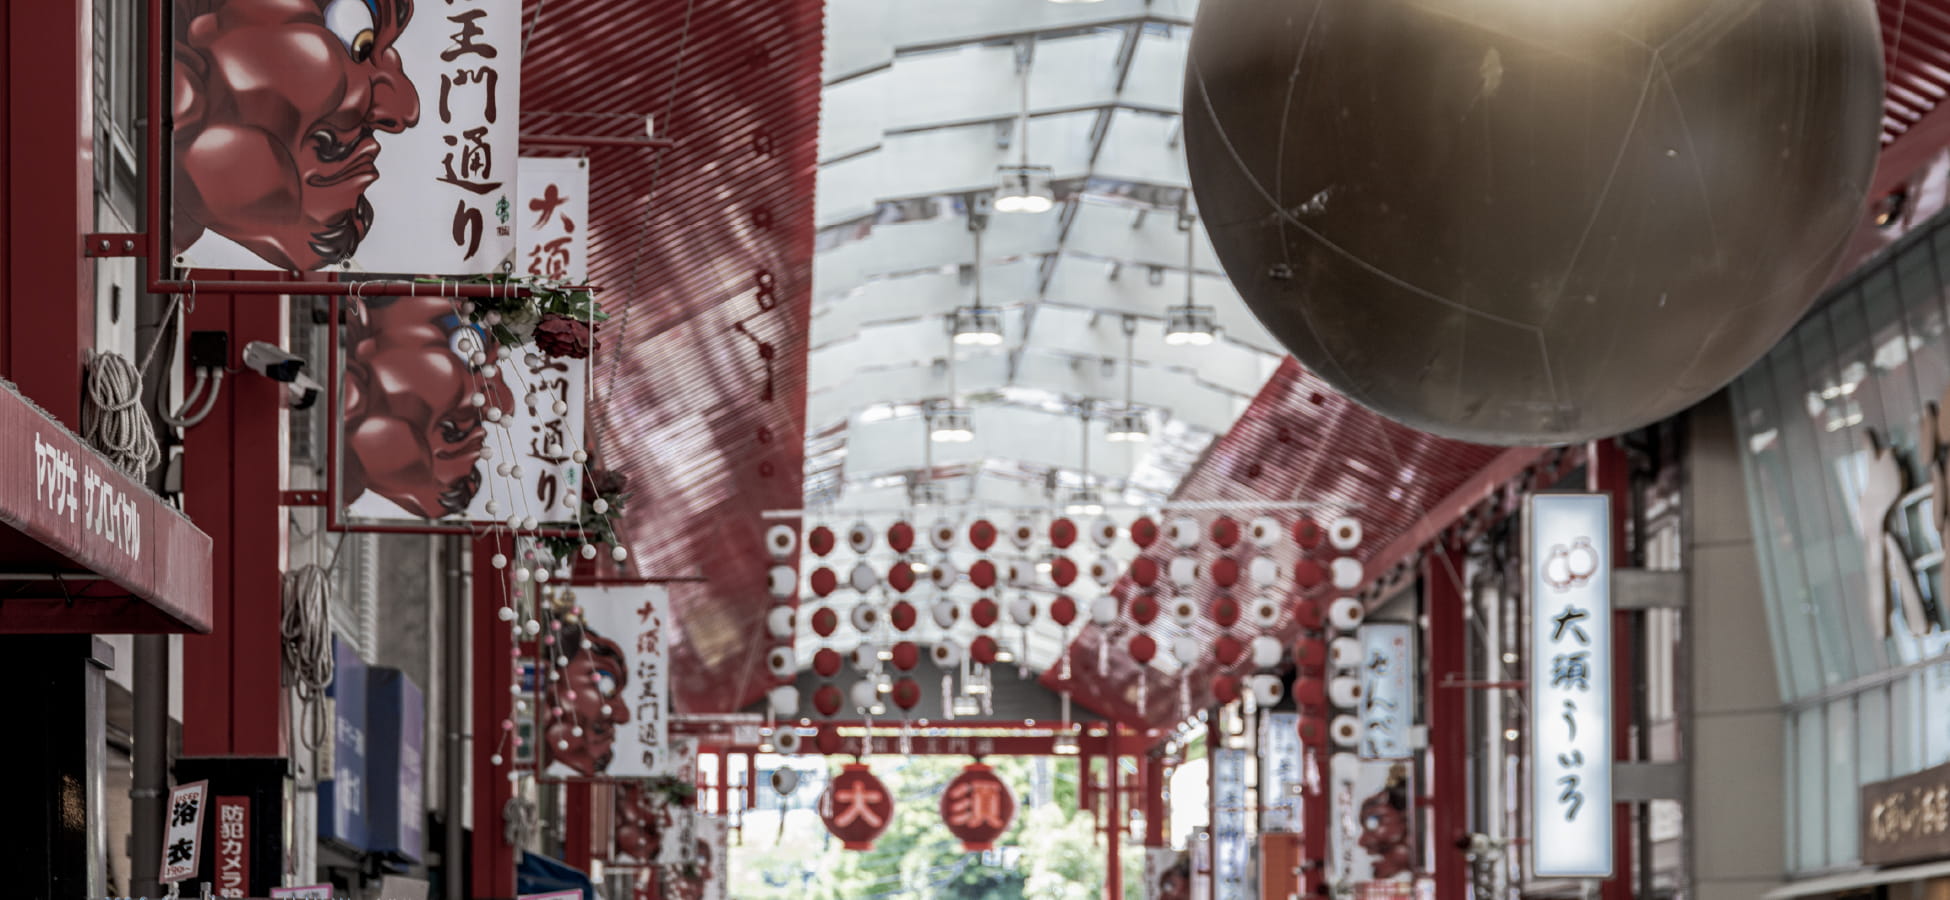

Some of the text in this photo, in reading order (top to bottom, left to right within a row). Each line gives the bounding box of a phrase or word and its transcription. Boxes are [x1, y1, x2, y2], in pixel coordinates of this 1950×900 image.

[436, 0, 503, 262] 王門通り
[35, 431, 141, 562] ヤマザキ サンロイヤル
[1550, 603, 1590, 823] 大須ういろ
[167, 799, 199, 866] 浴衣
[833, 779, 1004, 828] 大 須
